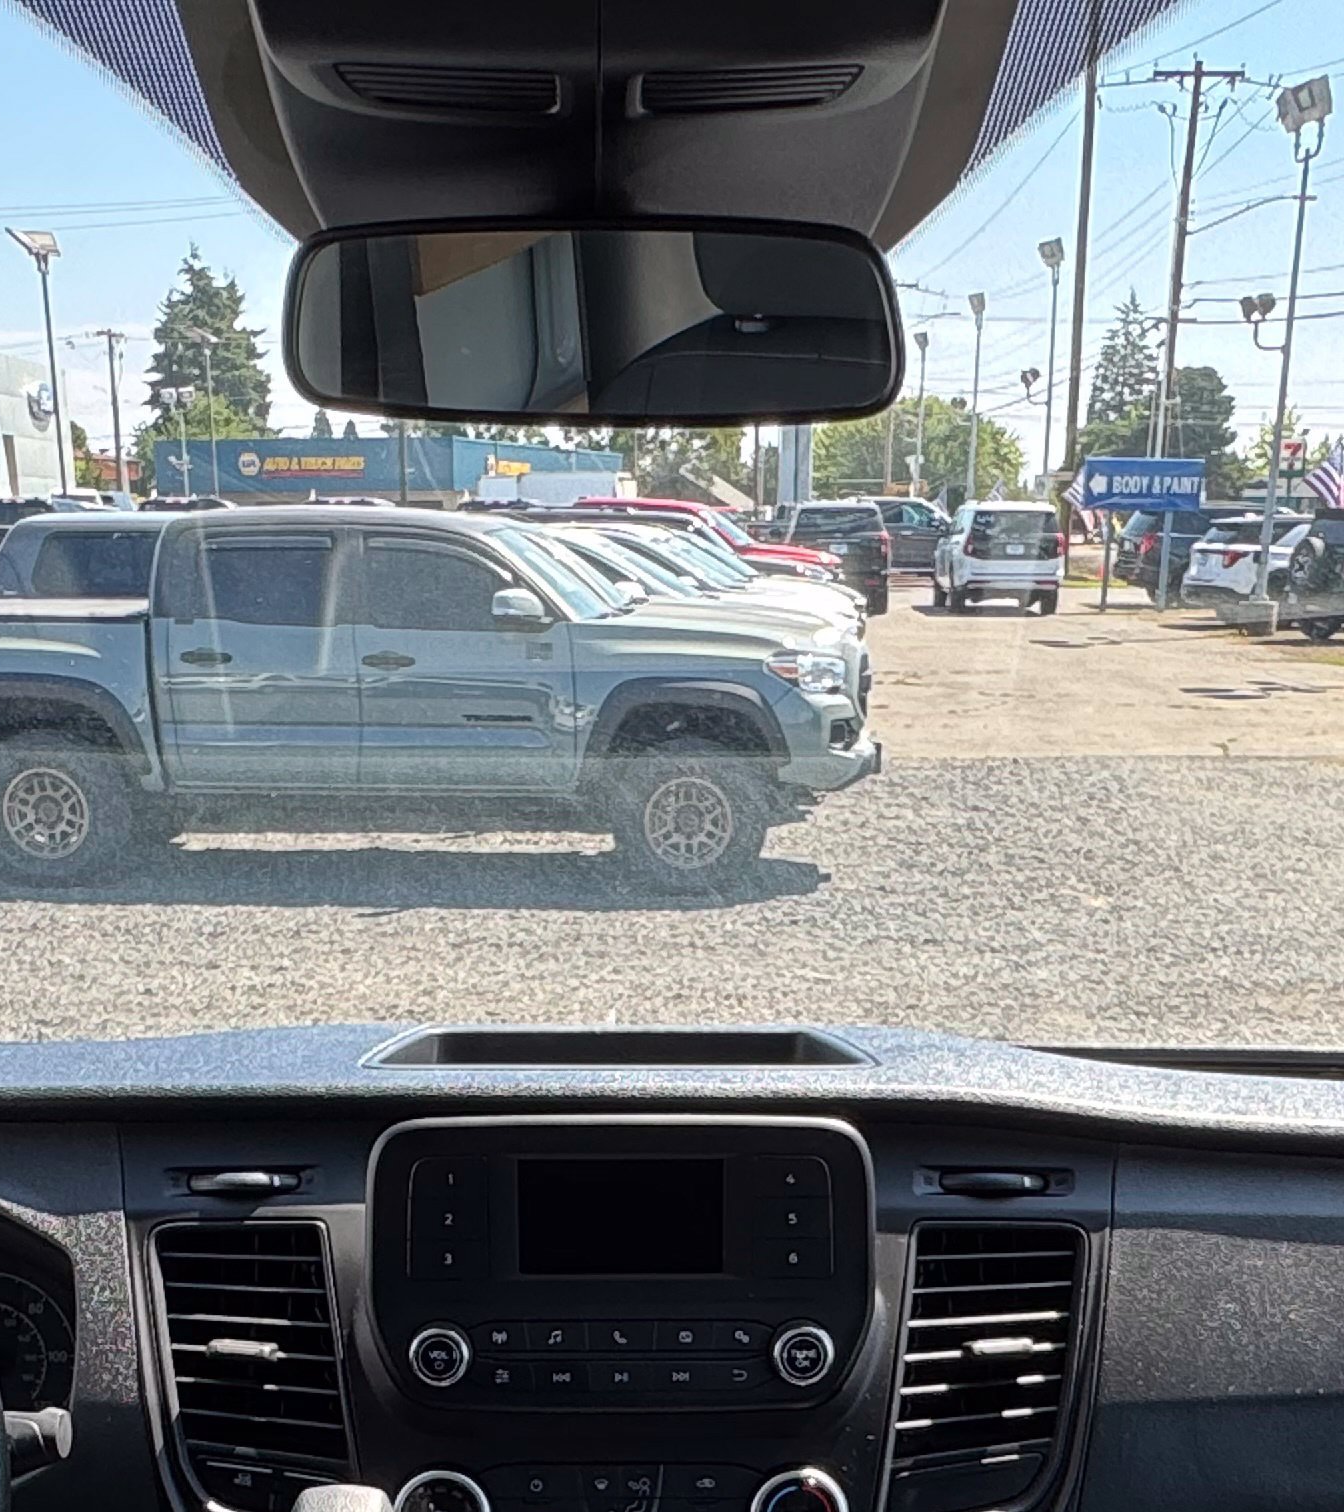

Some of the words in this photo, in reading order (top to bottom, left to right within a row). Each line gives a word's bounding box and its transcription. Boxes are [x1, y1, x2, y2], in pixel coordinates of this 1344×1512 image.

[1112, 476, 1150, 494] BODY
[1152, 476, 1162, 494] &
[1163, 476, 1200, 494] PAINT
[444, 1213, 454, 1225] 2
[788, 1213, 798, 1224] 5
[444, 1252, 453, 1264] 3
[788, 1252, 798, 1264] 6
